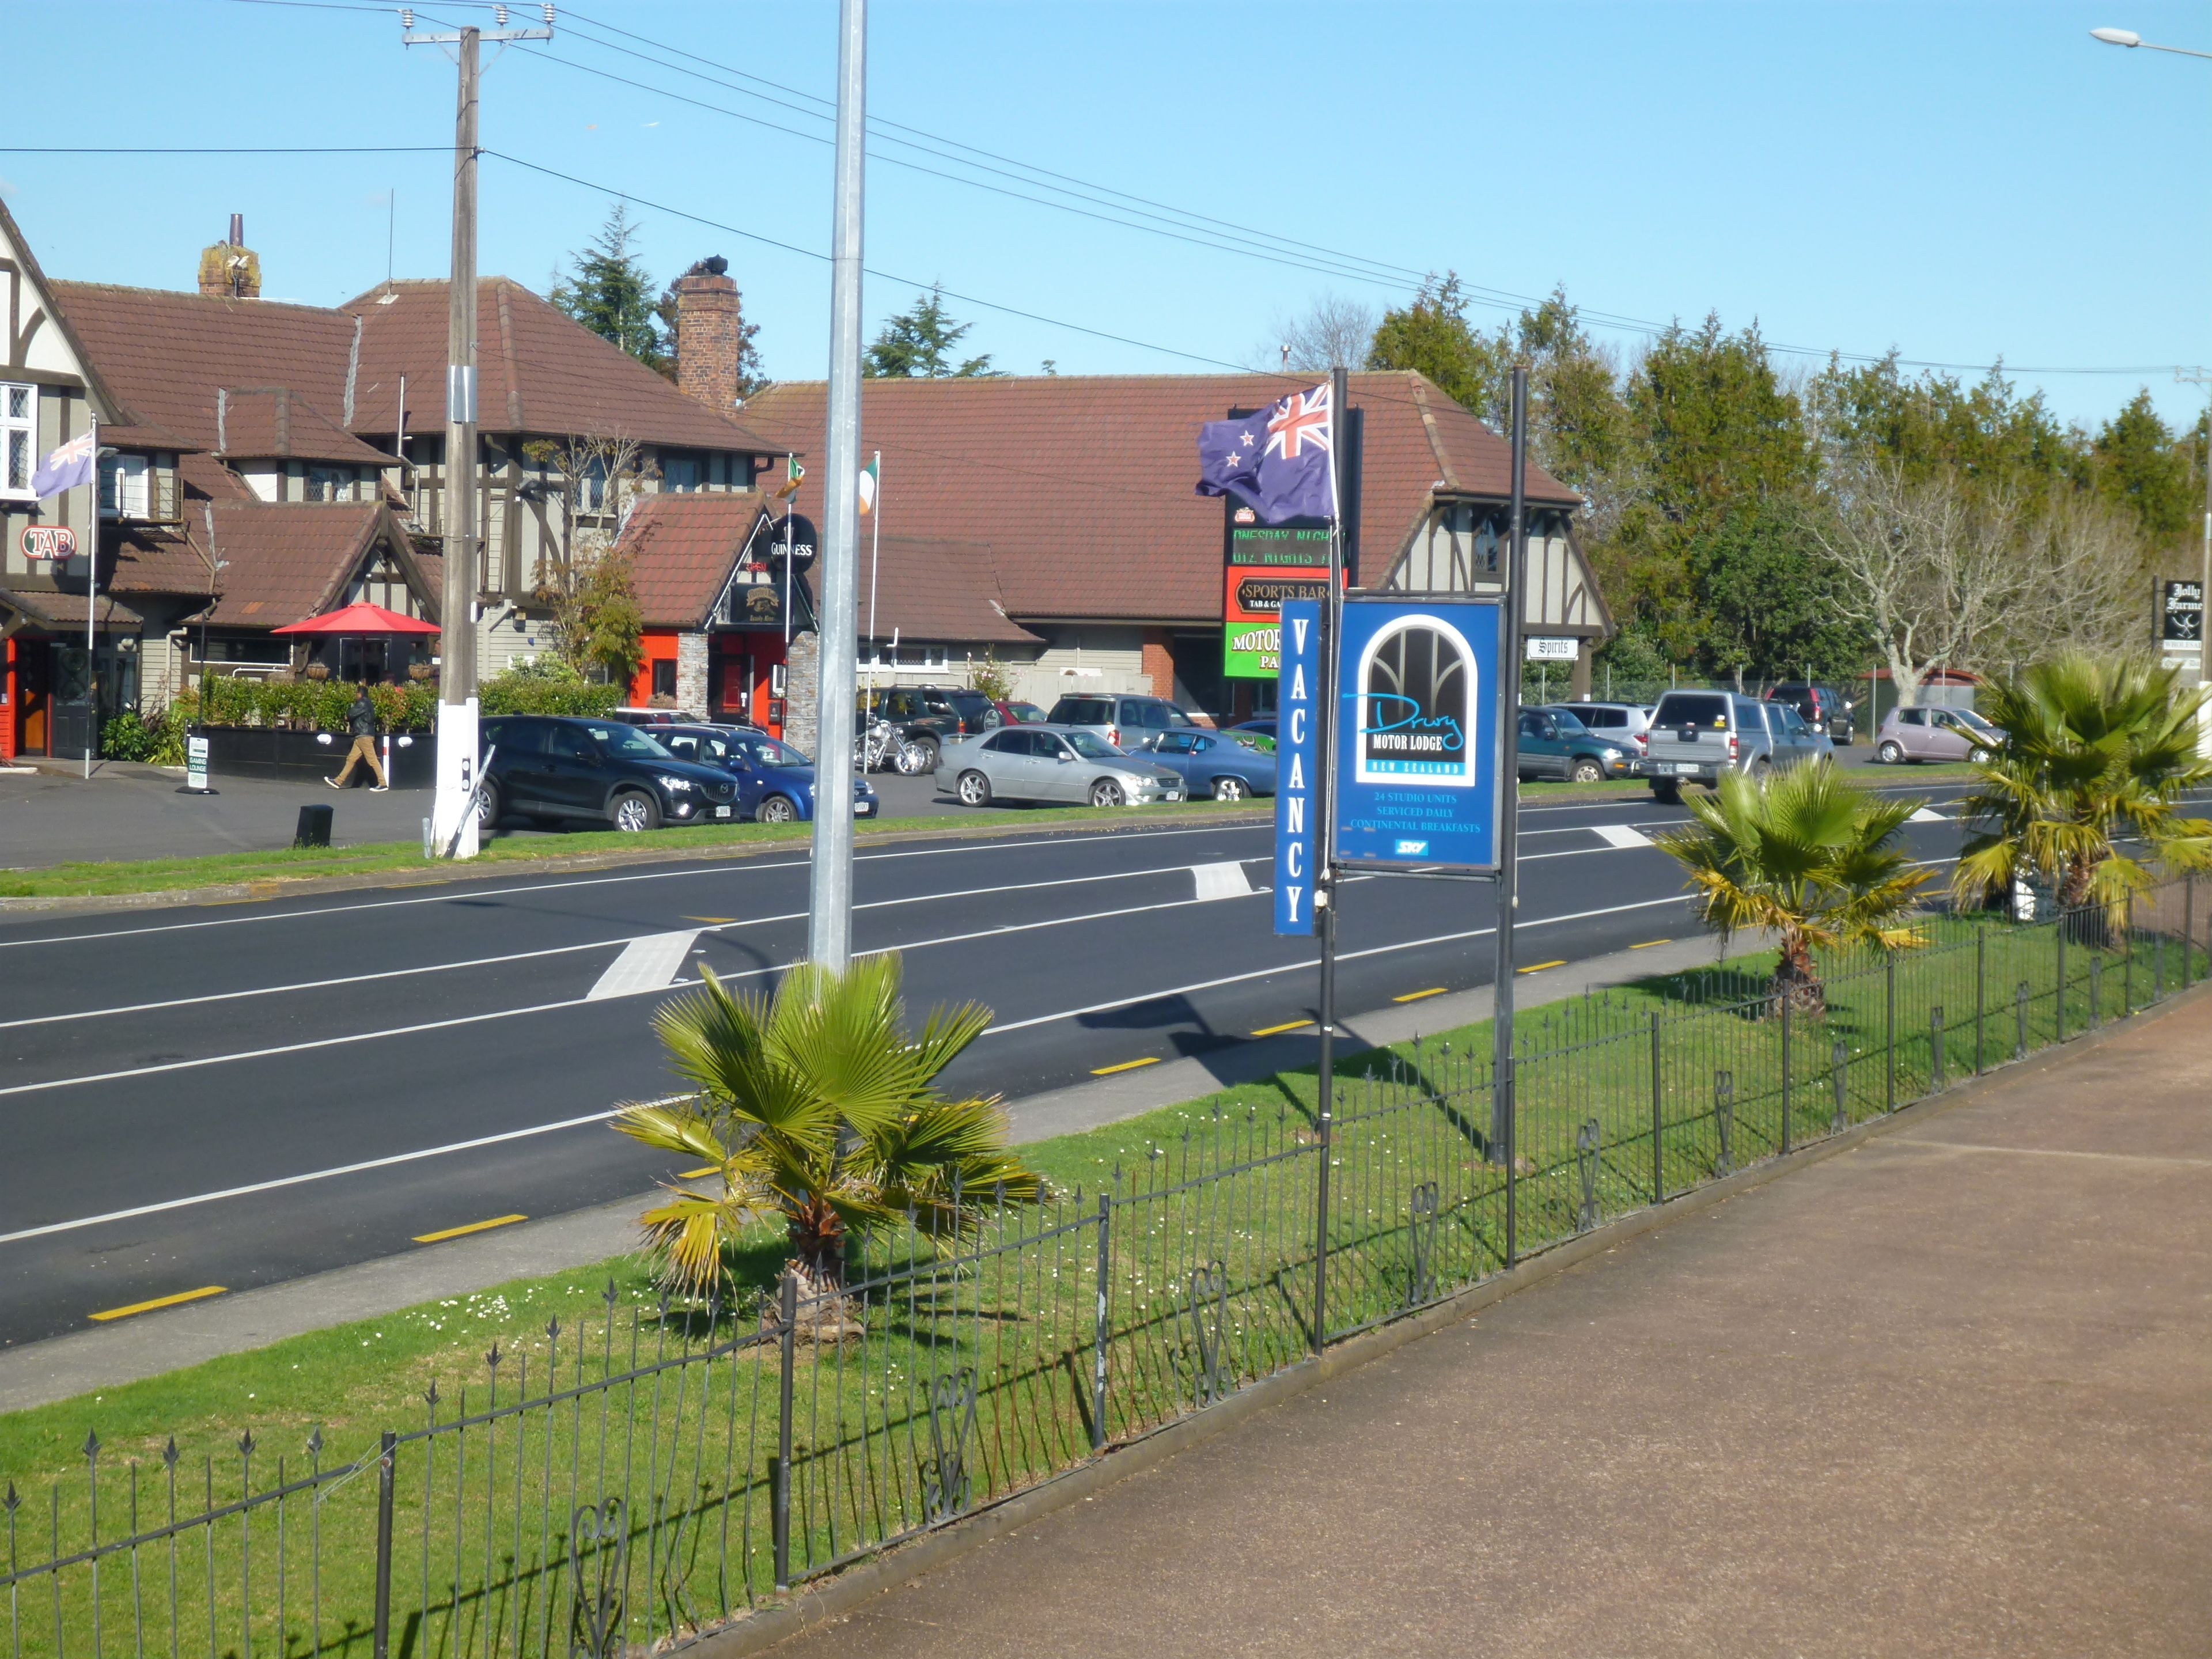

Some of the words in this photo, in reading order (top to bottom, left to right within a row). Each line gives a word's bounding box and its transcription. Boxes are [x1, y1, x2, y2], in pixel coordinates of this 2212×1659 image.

[30, 529, 71, 559] TAB
[1245, 585, 1295, 599] SPORTS
[1299, 586, 1325, 599] BAR
[2173, 584, 2201, 599] Jolly
[2166, 597, 2203, 613] Farme
[1539, 637, 1568, 656] Spirits
[1260, 656, 1279, 668] PA
[1373, 734, 1407, 749] MOTOR
[1411, 735, 1442, 751] LODGE
[189, 764, 207, 772] LOUNGE
[1286, 619, 1309, 922] VACANCY
[1373, 762, 1395, 771] NEW
[1404, 763, 1459, 774] ZEALAND
[1374, 792, 1385, 801] 24
[1388, 793, 1425, 802] STUDIO
[1427, 794, 1457, 804] UNITS
[1377, 807, 1423, 816] SERVICED
[1426, 808, 1454, 817] DAILY
[1350, 819, 1418, 831] CONTINENTAL
[1421, 822, 1480, 833] BREAKFASTS
[1397, 842, 1426, 854] SKY
